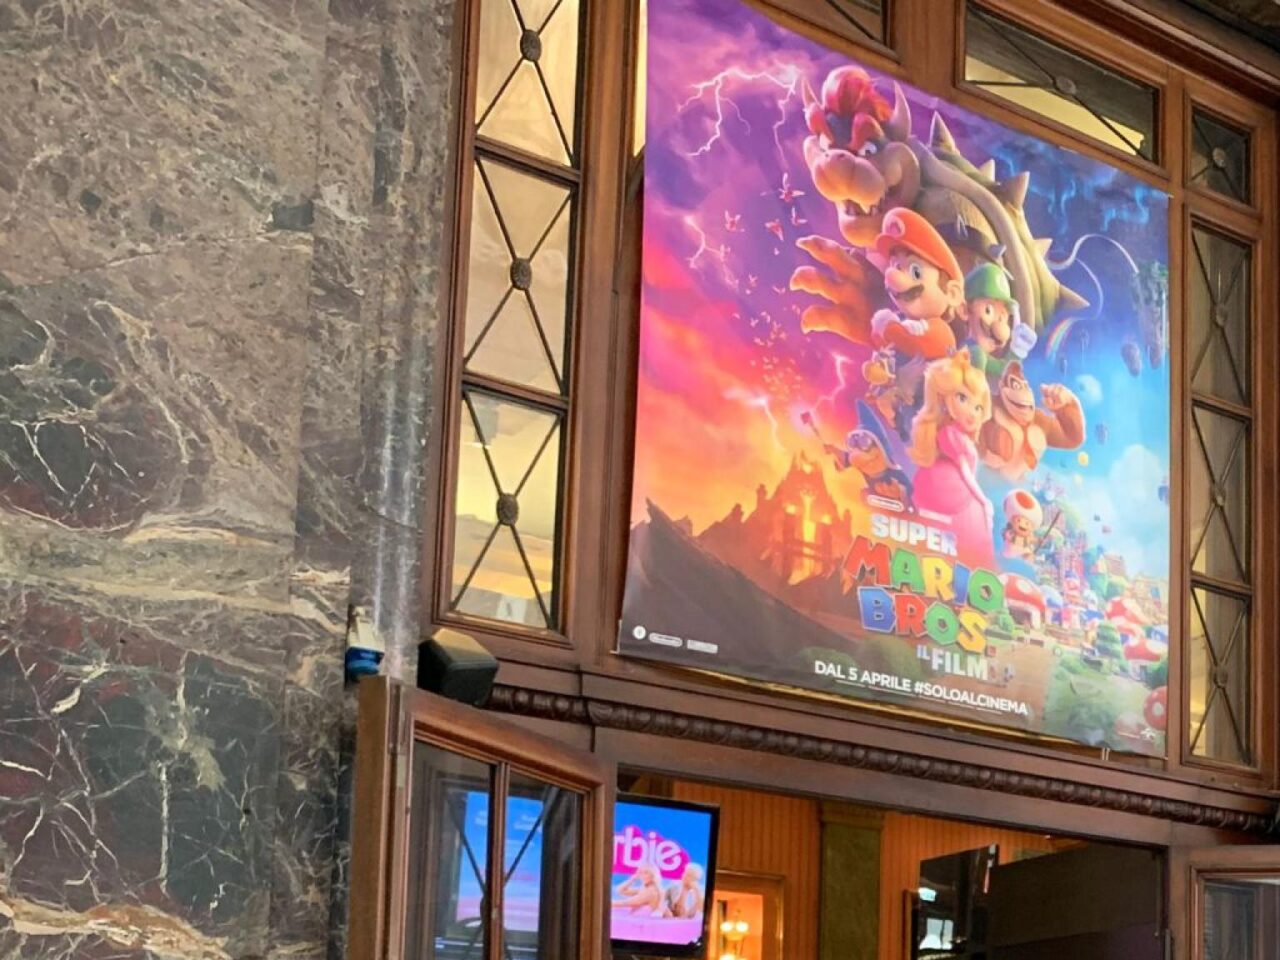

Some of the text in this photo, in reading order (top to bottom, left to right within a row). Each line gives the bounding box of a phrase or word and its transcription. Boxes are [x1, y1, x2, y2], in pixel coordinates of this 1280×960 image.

[870, 512, 958, 557] SUPER
[843, 535, 1005, 613] MARIO
[917, 644, 988, 681] IL FILM
[814, 660, 1028, 716] DAL 5 APRILE #SOLOALCINEMA
[613, 826, 682, 872] rbie
